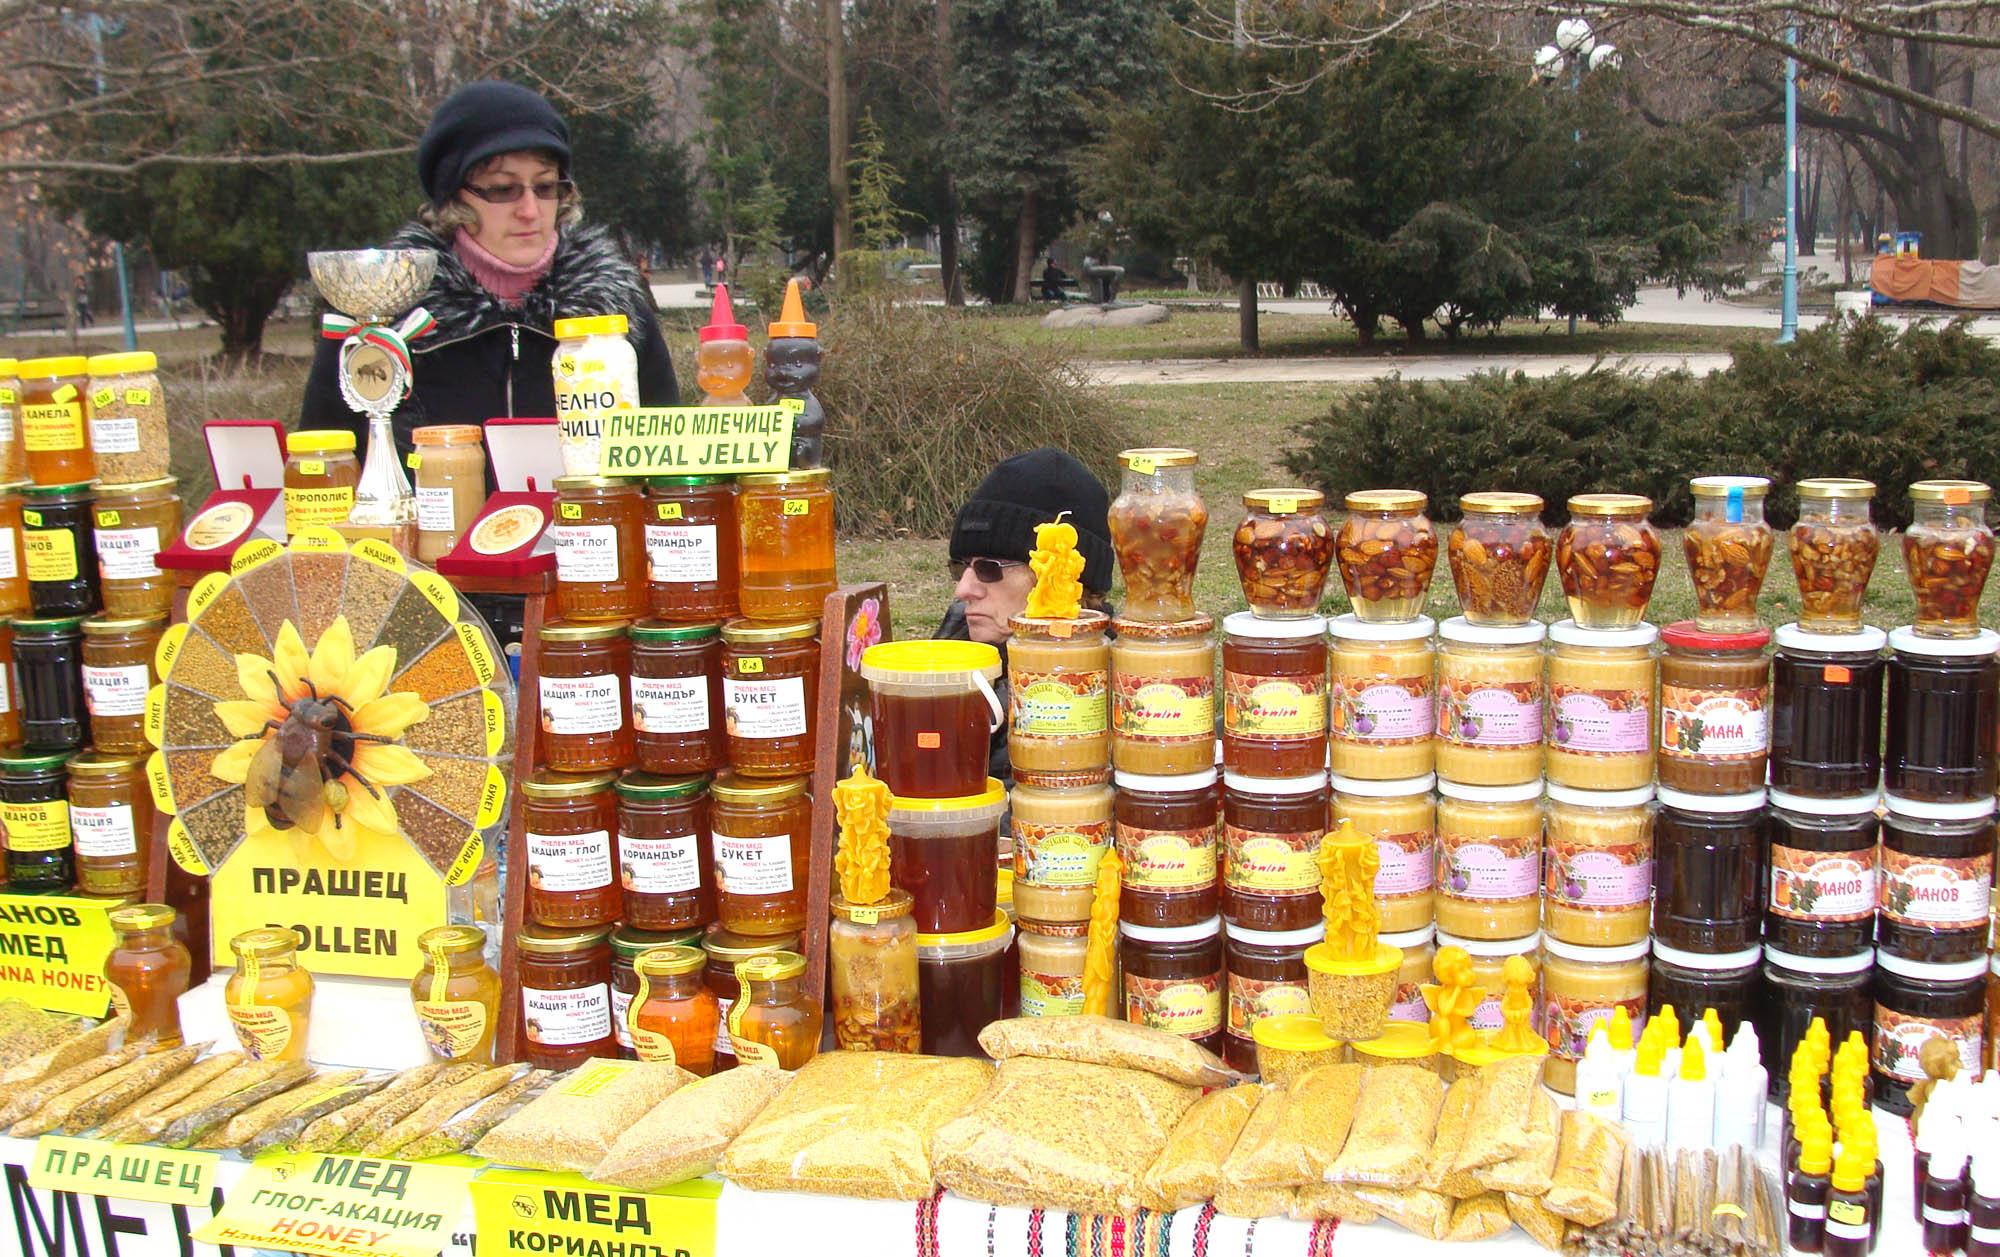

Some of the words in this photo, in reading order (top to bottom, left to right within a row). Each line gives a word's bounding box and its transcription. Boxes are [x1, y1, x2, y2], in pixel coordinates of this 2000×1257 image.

[611, 414, 686, 437] ПЧЕЛНО
[692, 411, 783, 436] МЛЕЧИЦЕ
[608, 445, 689, 468] ROYAL
[699, 441, 778, 465] JELLY
[583, 538, 608, 547] ГЛОГ
[232, 543, 278, 571] КОРИАНДЪР
[195, 582, 216, 606] БУКЕТ
[427, 583, 446, 604] МАК
[461, 624, 493, 683] СЛЪНЧОГЛЕД
[585, 688, 611, 699] ГЛОГ
[635, 689, 696, 700] КОРИАНДЪР
[734, 692, 777, 703] БУКЕТ
[150, 702, 161, 730] БУКЕТ
[487, 708, 496, 733] РОЗА
[1702, 724, 1744, 739] МАНА
[155, 771, 168, 798] БУКЕТ
[483, 783, 498, 813] БУКЕТ
[531, 846, 566, 857] АКАЦИЯ
[576, 844, 602, 855] ГЛОГ
[623, 849, 686, 860] КОРИАНДЪР
[721, 848, 763, 860] БУКЕТ
[253, 867, 408, 905] ПРАШЕЦ
[1815, 879, 1862, 897] МАНОВ
[1908, 885, 1959, 903] МАНОВ
[0, 904, 82, 926] АНОВ
[0, 933, 68, 964] МЕД
[265, 924, 397, 956] OLLEN
[0, 965, 35, 984] NNA
[42, 969, 107, 992] HONEY
[529, 1000, 567, 1012] АКАЦИЯ
[577, 997, 601, 1008] ГЛОГ
[45, 1149, 202, 1194] ПРАШЕЦ
[312, 1156, 413, 1200] МЕД
[251, 1189, 444, 1231] ГЛОГ-АКАЦИЯ
[544, 1190, 652, 1235] МЕД
[271, 1218, 393, 1247] HONEY
